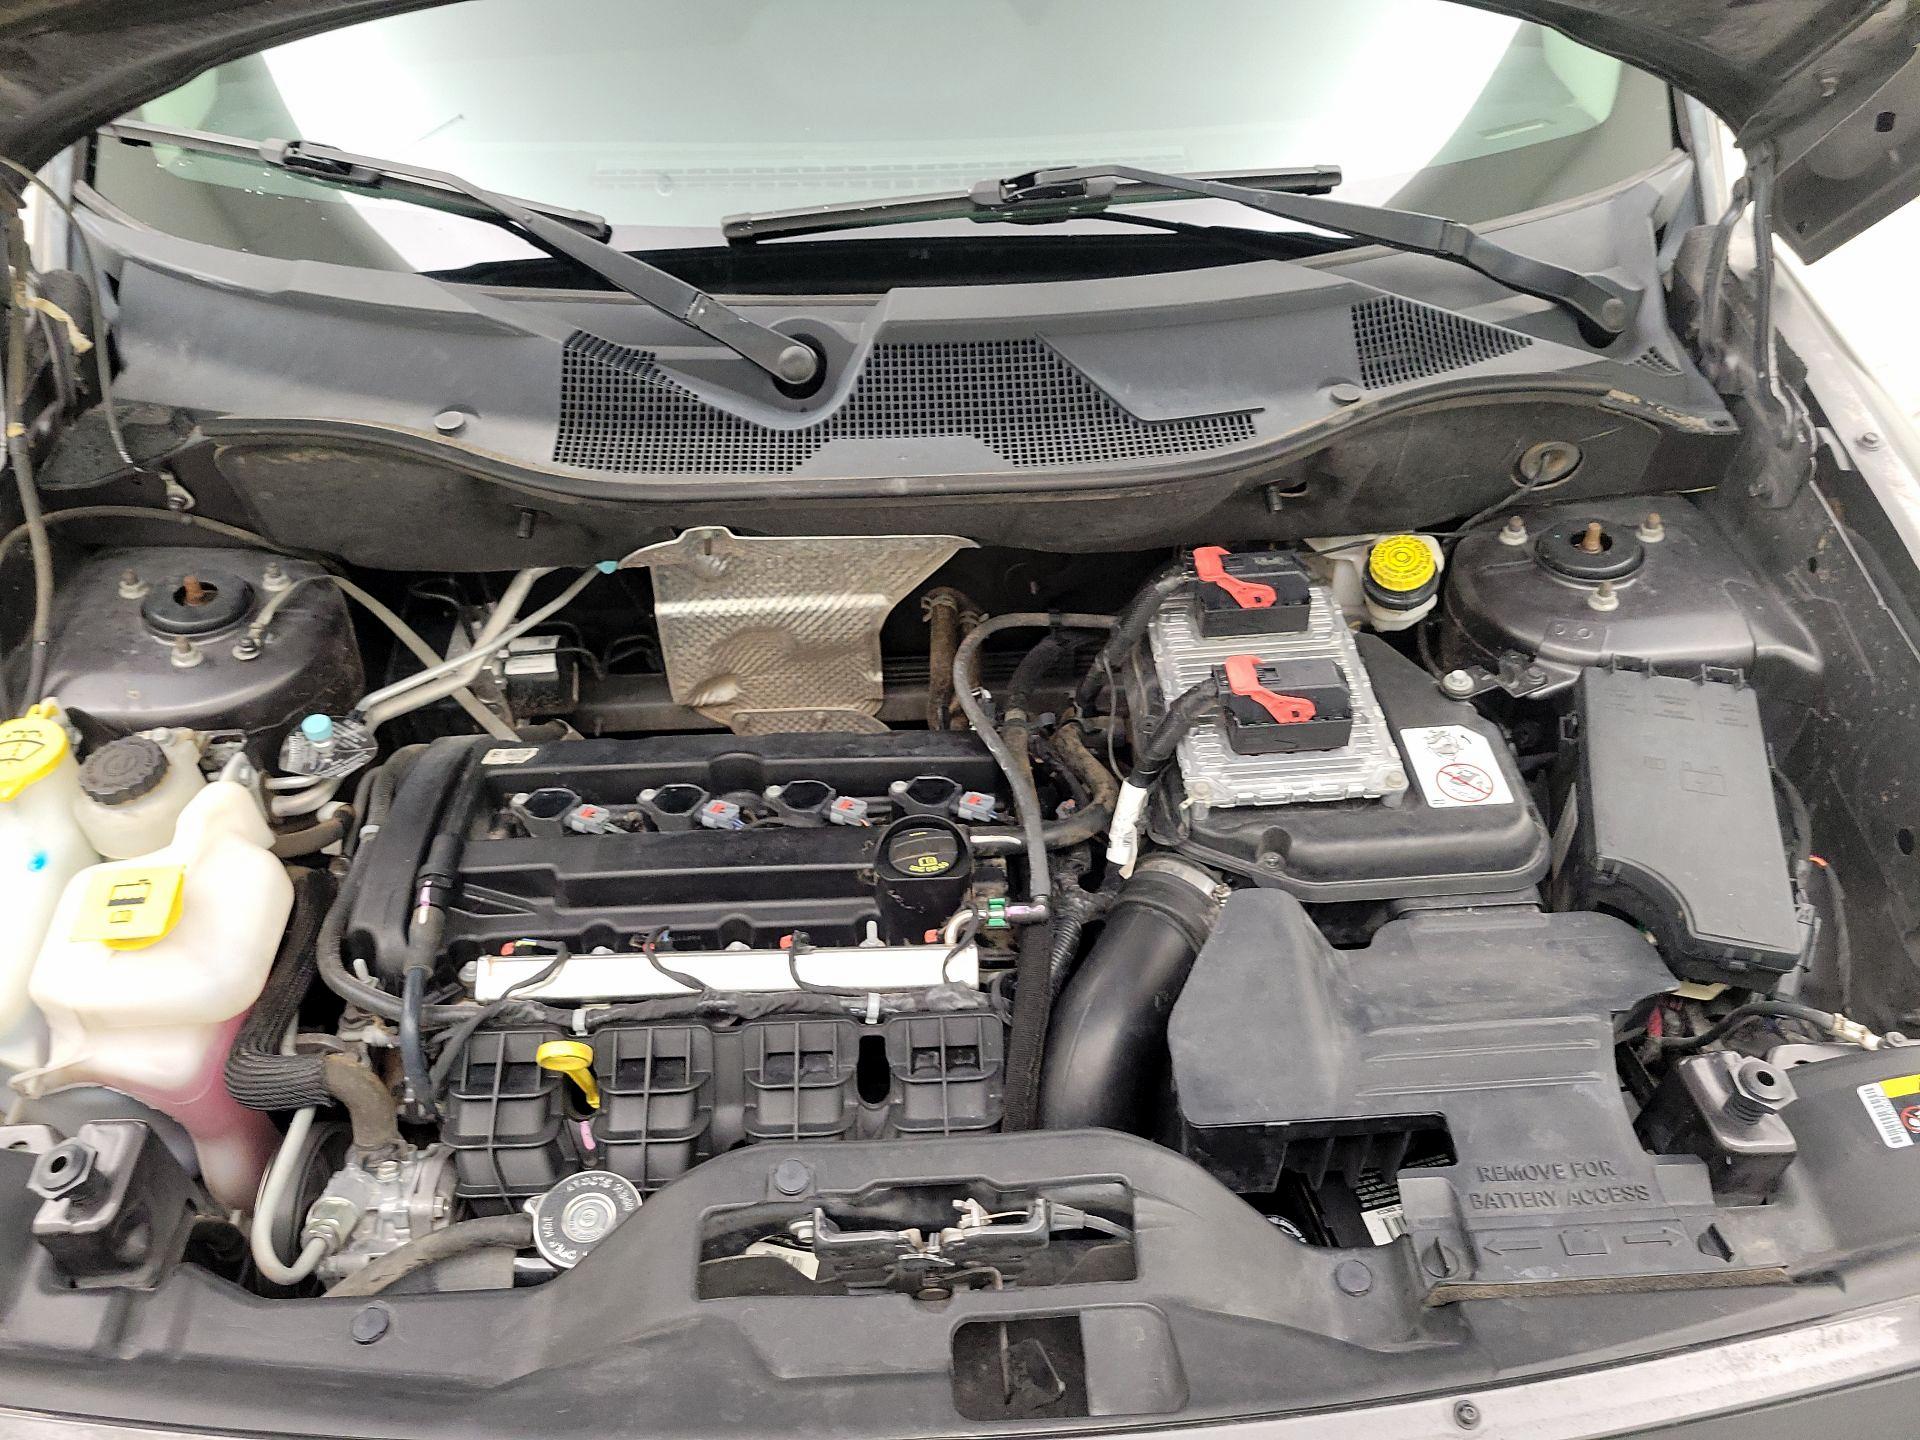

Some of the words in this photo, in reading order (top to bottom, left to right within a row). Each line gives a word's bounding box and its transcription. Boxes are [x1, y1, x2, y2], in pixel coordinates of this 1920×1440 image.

[1477, 1162, 1565, 1182] REMOVE
[1570, 1160, 1617, 1179] FOR
[1469, 1190, 1559, 1210] BATTERY
[1567, 1185, 1650, 1206] ACCESS
